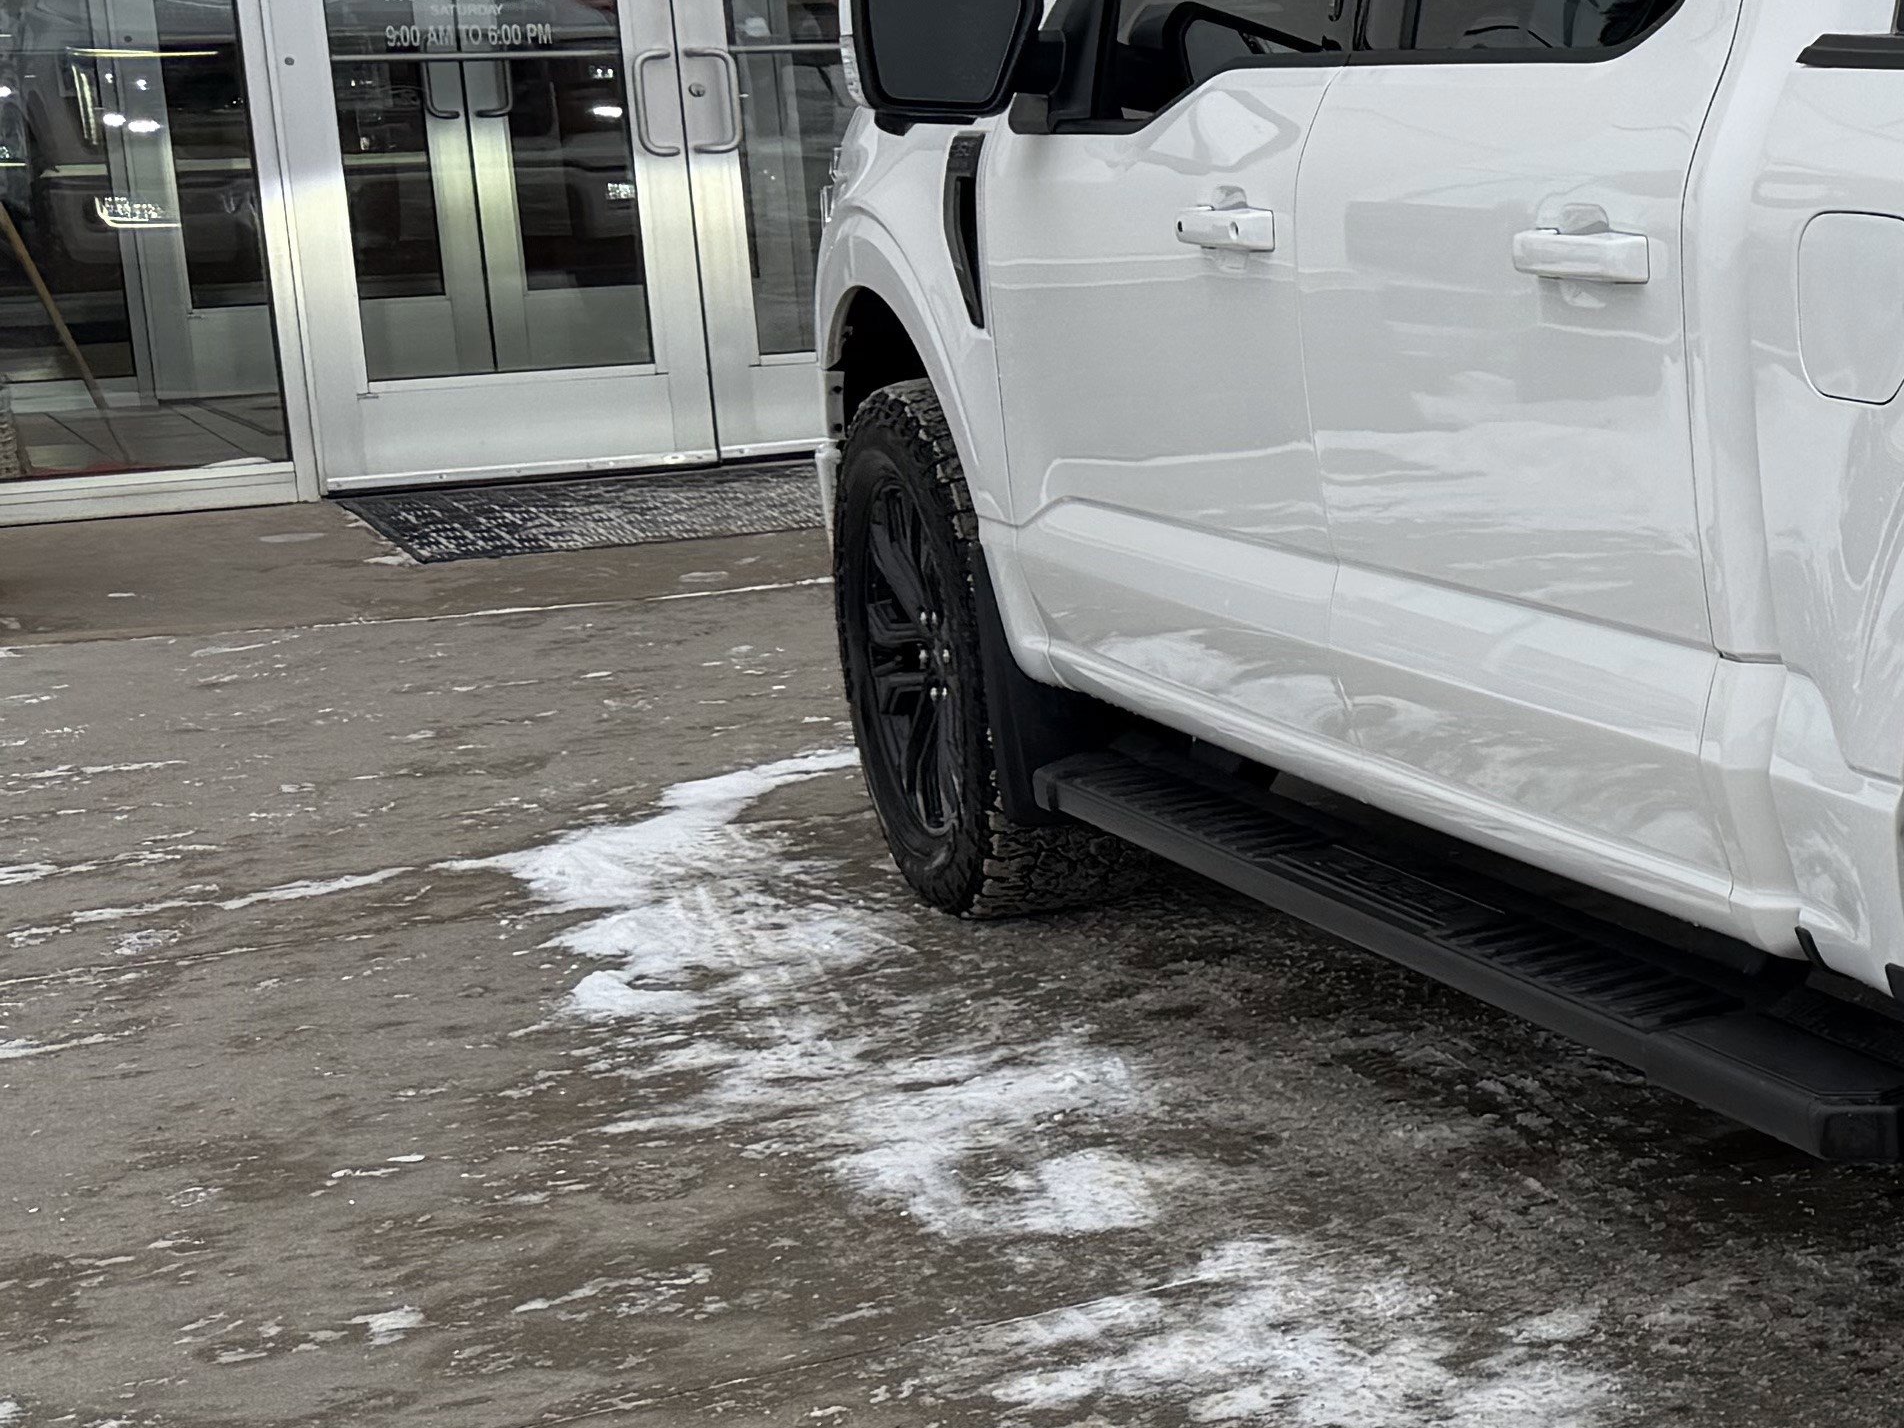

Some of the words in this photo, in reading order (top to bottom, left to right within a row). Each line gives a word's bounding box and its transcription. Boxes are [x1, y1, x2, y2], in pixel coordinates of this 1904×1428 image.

[430, 3, 504, 16] SATURDAY
[385, 24, 420, 47] 9:00
[427, 24, 456, 46] AM
[459, 24, 483, 46] TO
[487, 24, 522, 46] 6:00
[526, 23, 553, 45] PM
